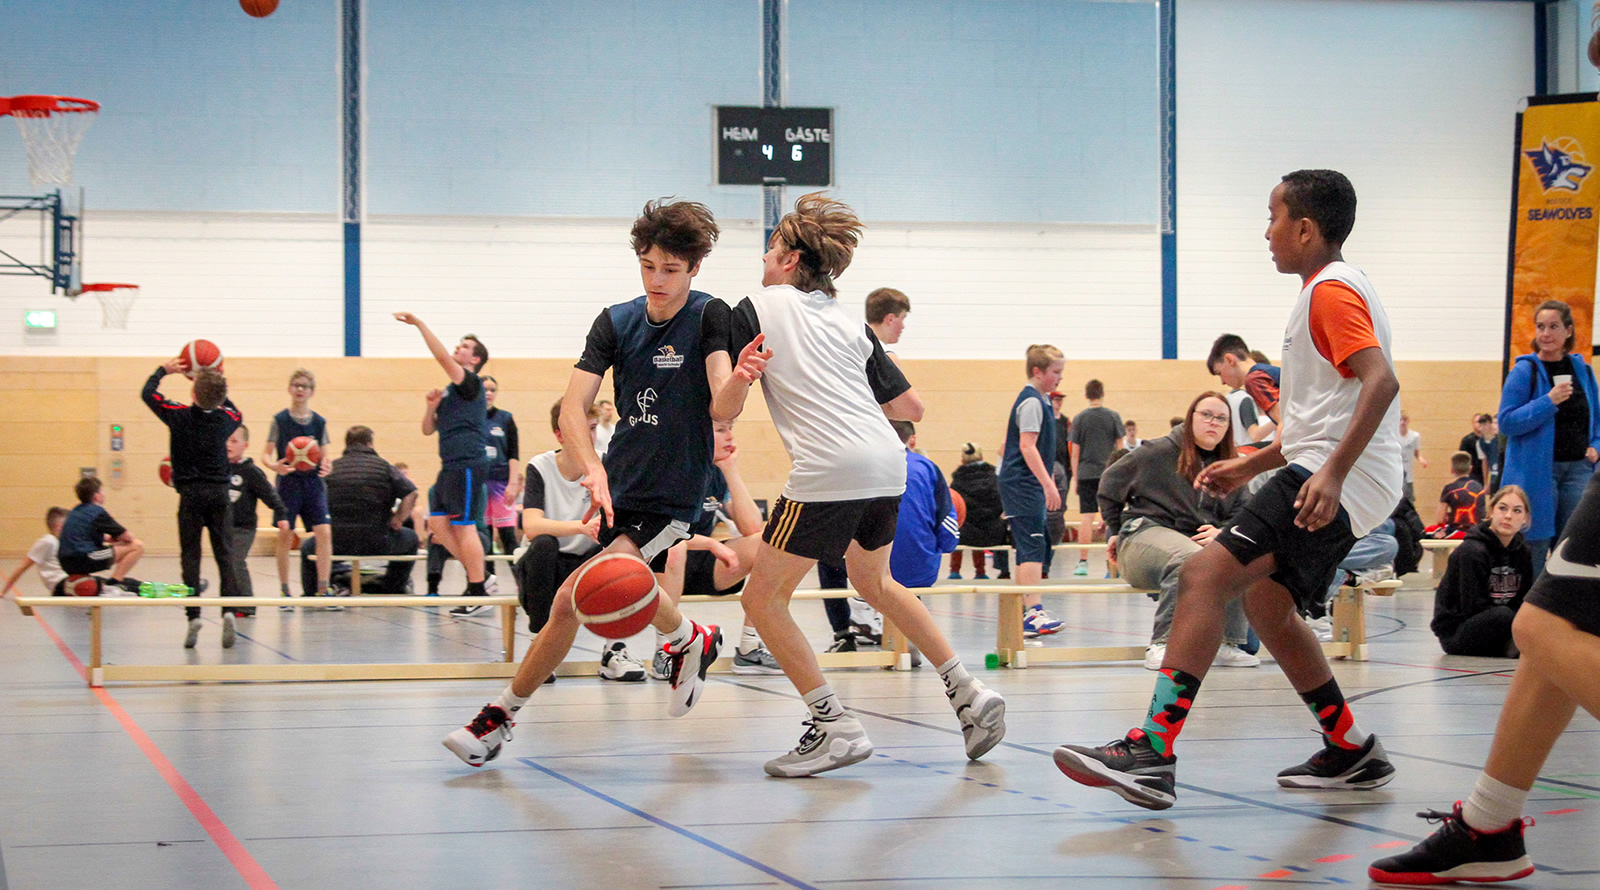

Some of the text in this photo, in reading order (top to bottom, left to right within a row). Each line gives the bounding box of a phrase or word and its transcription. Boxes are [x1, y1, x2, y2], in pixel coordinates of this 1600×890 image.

[723, 126, 830, 143] HEIM GÄSTE
[762, 144, 803, 162] 4 6
[1528, 207, 1593, 221] SEAWOLVES
